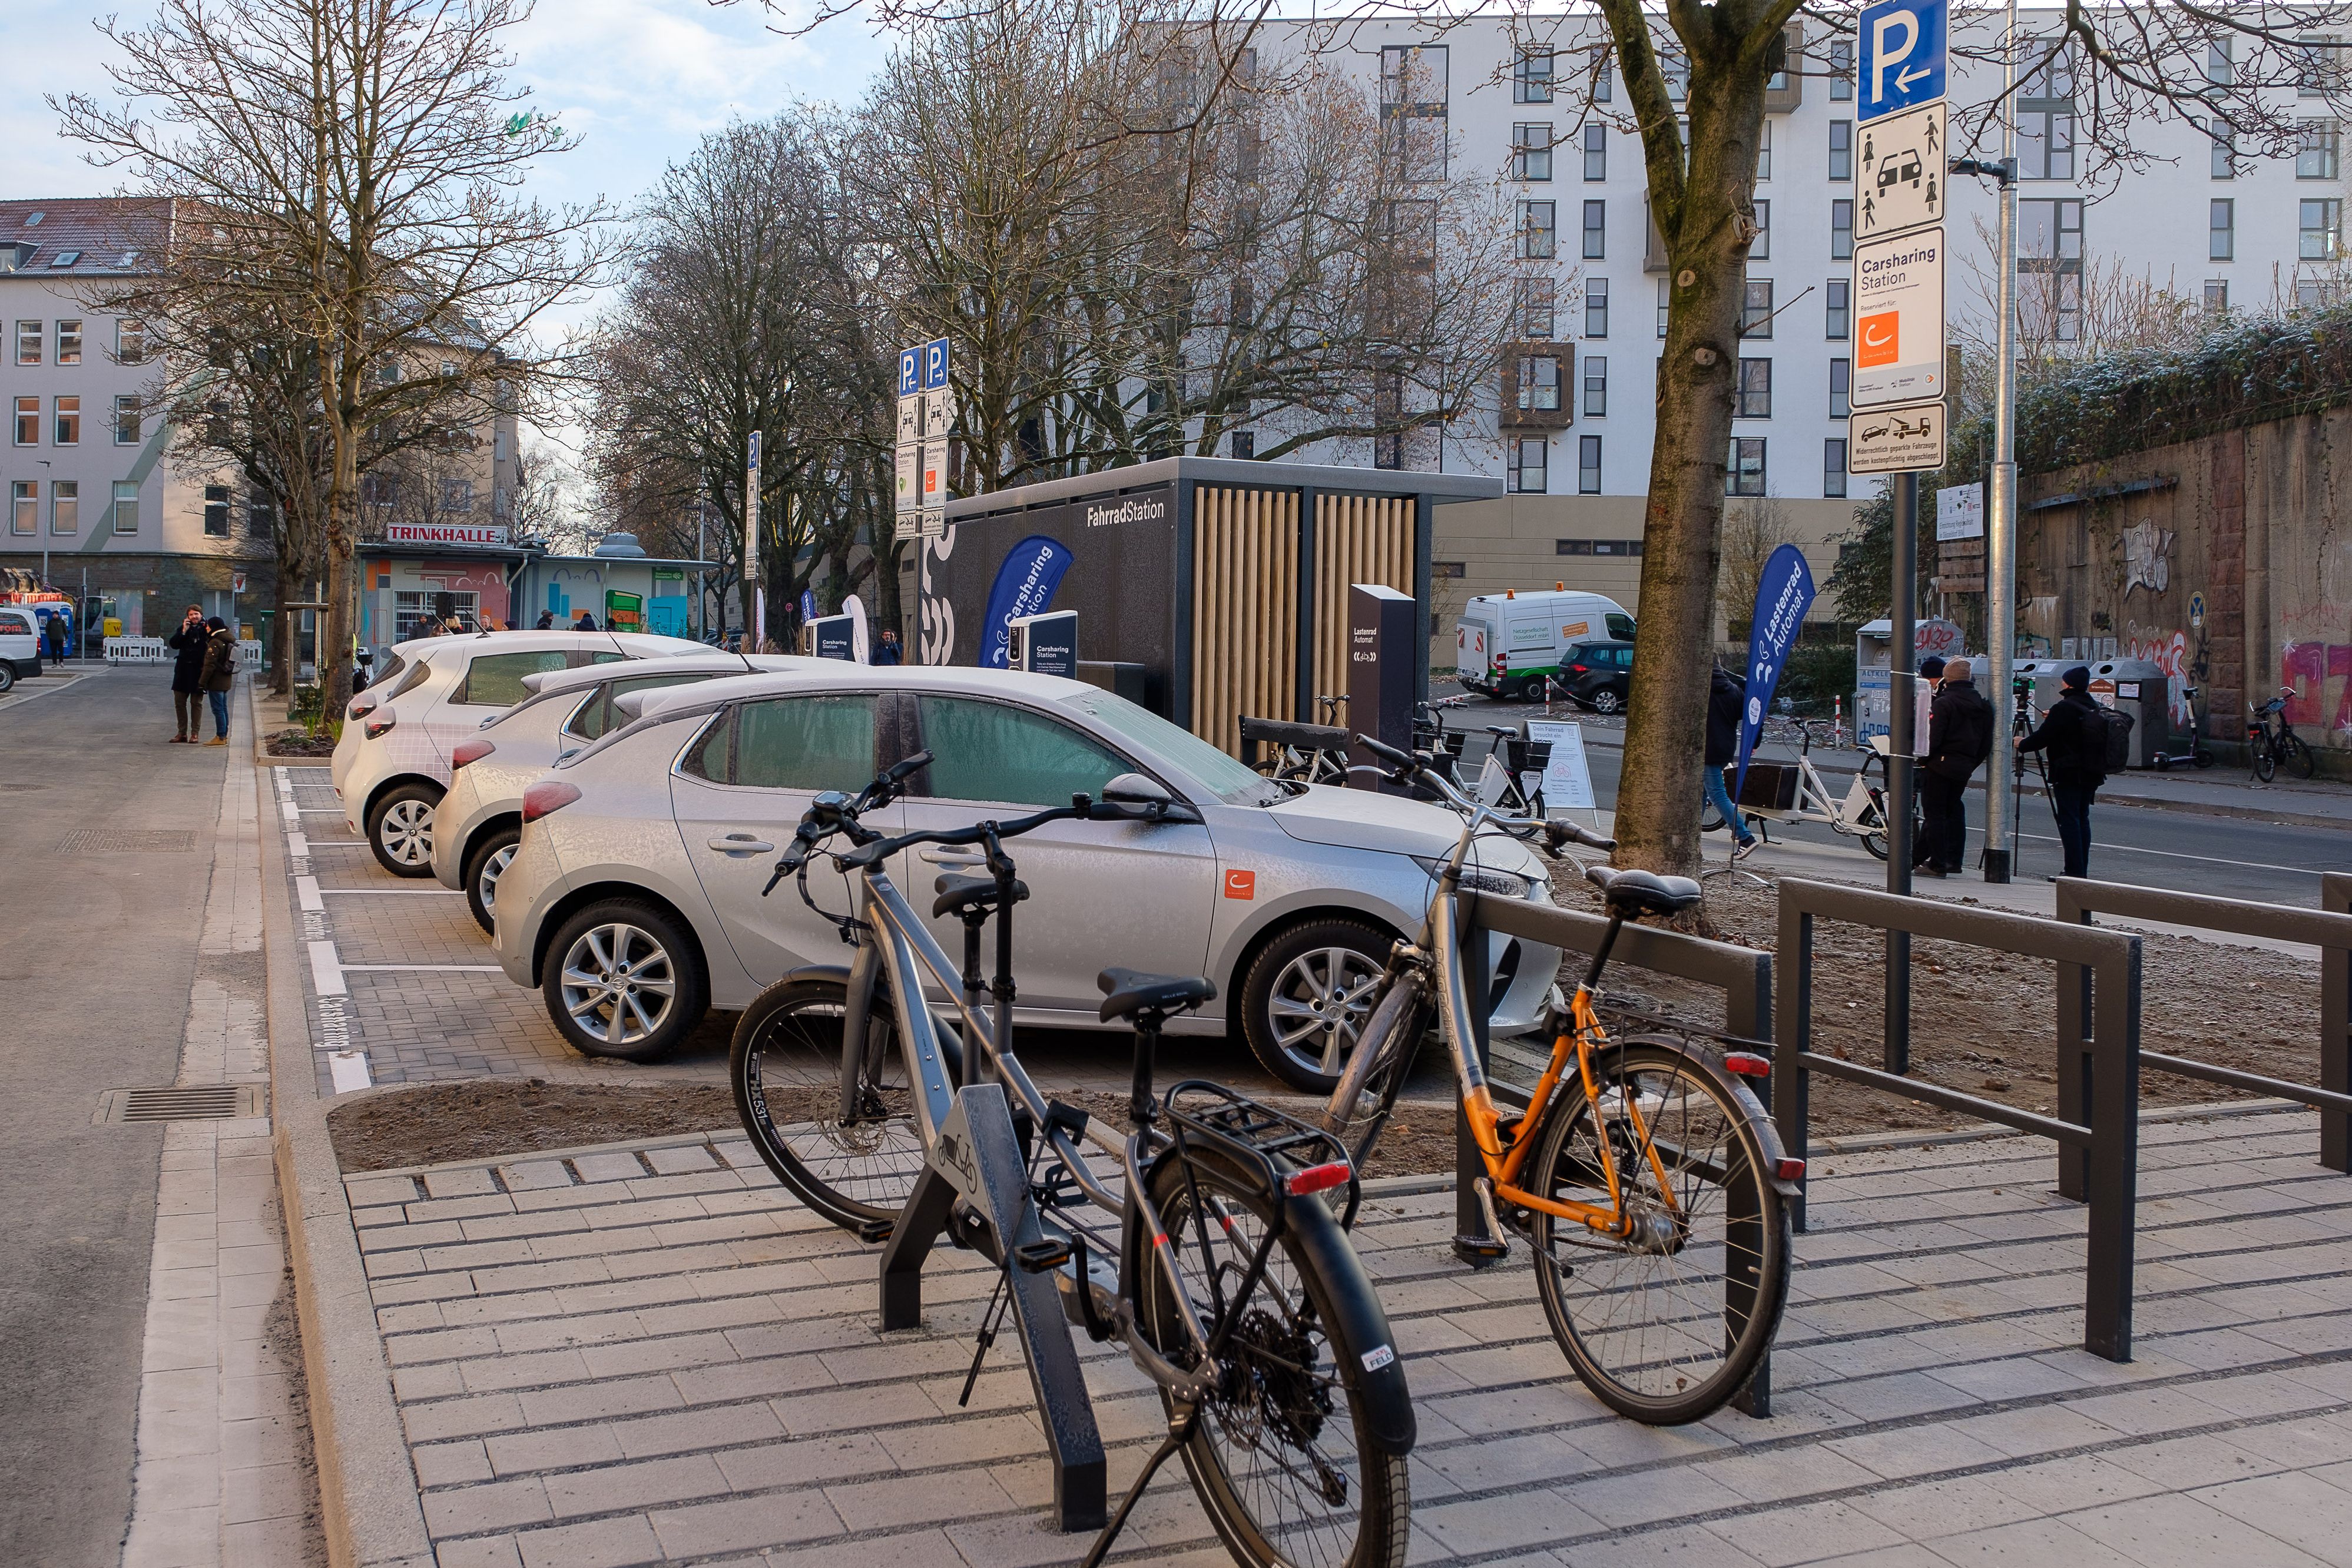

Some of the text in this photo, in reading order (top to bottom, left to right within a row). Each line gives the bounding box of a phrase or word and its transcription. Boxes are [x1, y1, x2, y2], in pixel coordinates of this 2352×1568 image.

[1871, 9, 1919, 104] P
[1861, 248, 1936, 274] Carsharing
[1861, 271, 1906, 290] Station
[1860, 301, 1886, 311] Reserviert
[903, 354, 914, 391] P
[929, 346, 942, 383] P
[750, 438, 756, 465] P
[898, 450, 916, 459] Carsharing
[926, 446, 946, 454] Carsharing
[1856, 442, 1937, 455] Widerrechtlich geparkte Fahrzeuge
[1870, 455, 1905, 465] kostenpflichtig
[1907, 452, 1940, 462] abgeschleppt.
[1087, 498, 1164, 528] FahrradStation
[390, 526, 496, 543] TRINKHALLE
[1005, 546, 1052, 626] Carsharing
[1026, 585, 1047, 617] ation
[1764, 561, 1802, 642] Lastenrad
[1354, 627, 1377, 635] Lastenrad
[1513, 626, 1548, 635] Netzgesellschaft
[1773, 589, 1804, 657] Automat
[314, 997, 359, 1047] Carsharing
[1369, 1352, 1392, 1368] FELD
[1375, 1348, 1388, 1357] XXL
